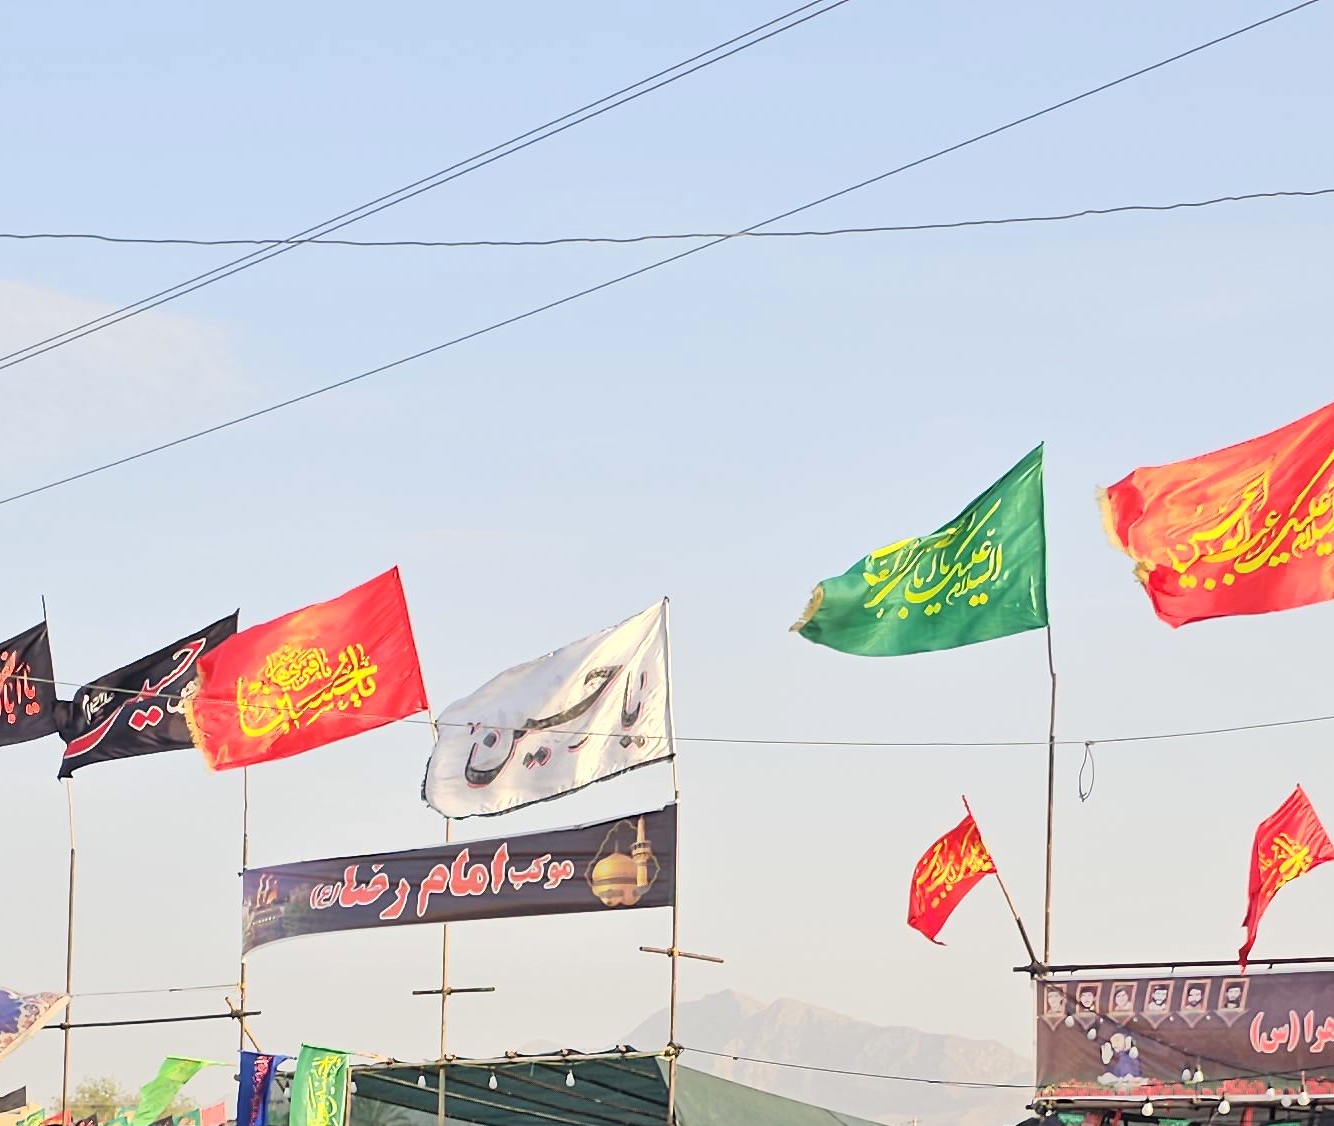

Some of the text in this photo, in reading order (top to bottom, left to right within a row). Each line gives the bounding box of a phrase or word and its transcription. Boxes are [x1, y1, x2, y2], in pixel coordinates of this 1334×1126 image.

[465, 664, 624, 788] حسین
[338, 863, 411, 920] رضا
[415, 842, 510, 918] امام
[507, 853, 575, 890] موکب
[1250, 1009, 1301, 1054] (س)
